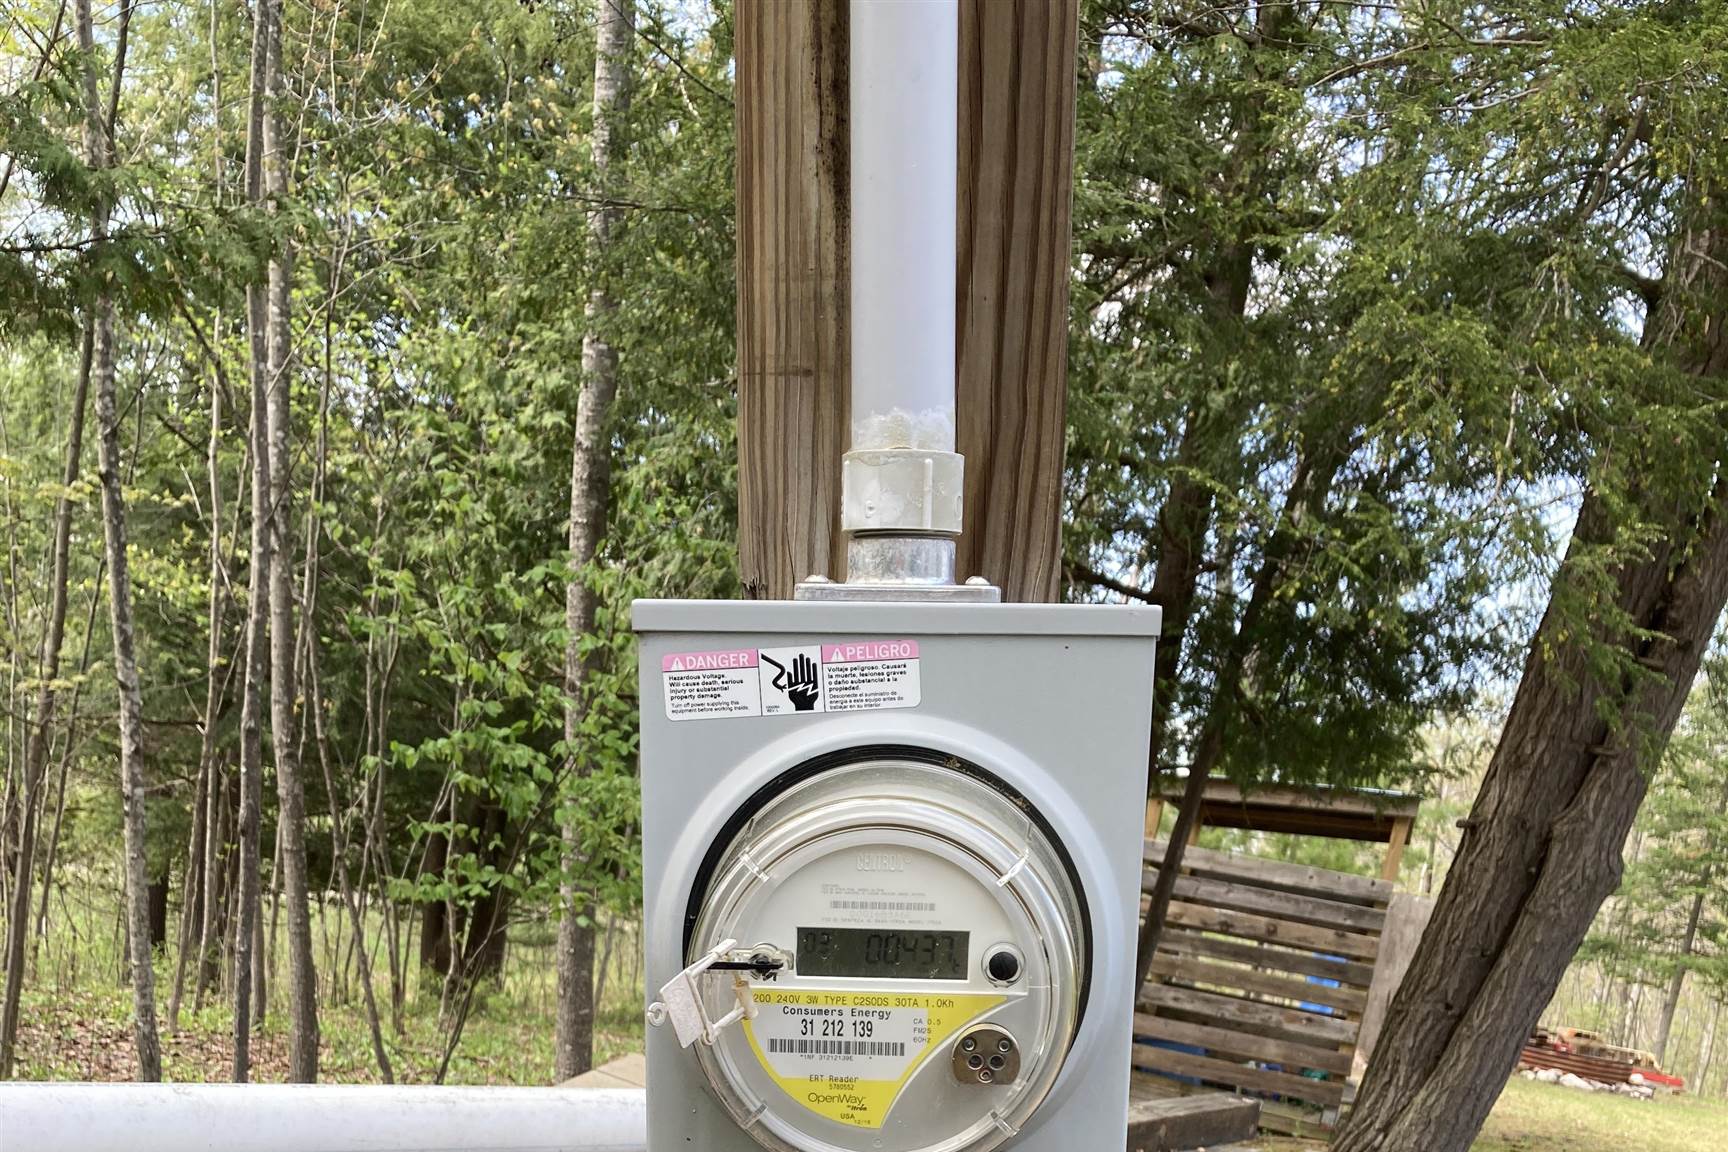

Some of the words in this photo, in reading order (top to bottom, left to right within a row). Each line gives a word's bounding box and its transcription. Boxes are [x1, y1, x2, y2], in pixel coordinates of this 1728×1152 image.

[846, 643, 911, 660] PELIGRO
[686, 652, 749, 670] DANGER
[864, 933, 954, 965] 00437
[753, 994, 771, 1002] 200
[776, 994, 800, 1004] 240V
[806, 995, 818, 1004] 3W
[824, 996, 847, 1005] TYPE
[895, 998, 919, 1007] 30TA
[926, 999, 954, 1008] 1.0Kh
[782, 1006, 843, 1016] Consumers
[851, 1008, 891, 1020] Energy
[801, 1018, 814, 1035] 31
[822, 1019, 844, 1036] 212
[852, 1020, 873, 1037] 139
[829, 1075, 858, 1083] Reader
[808, 1092, 864, 1104] OpenWay
